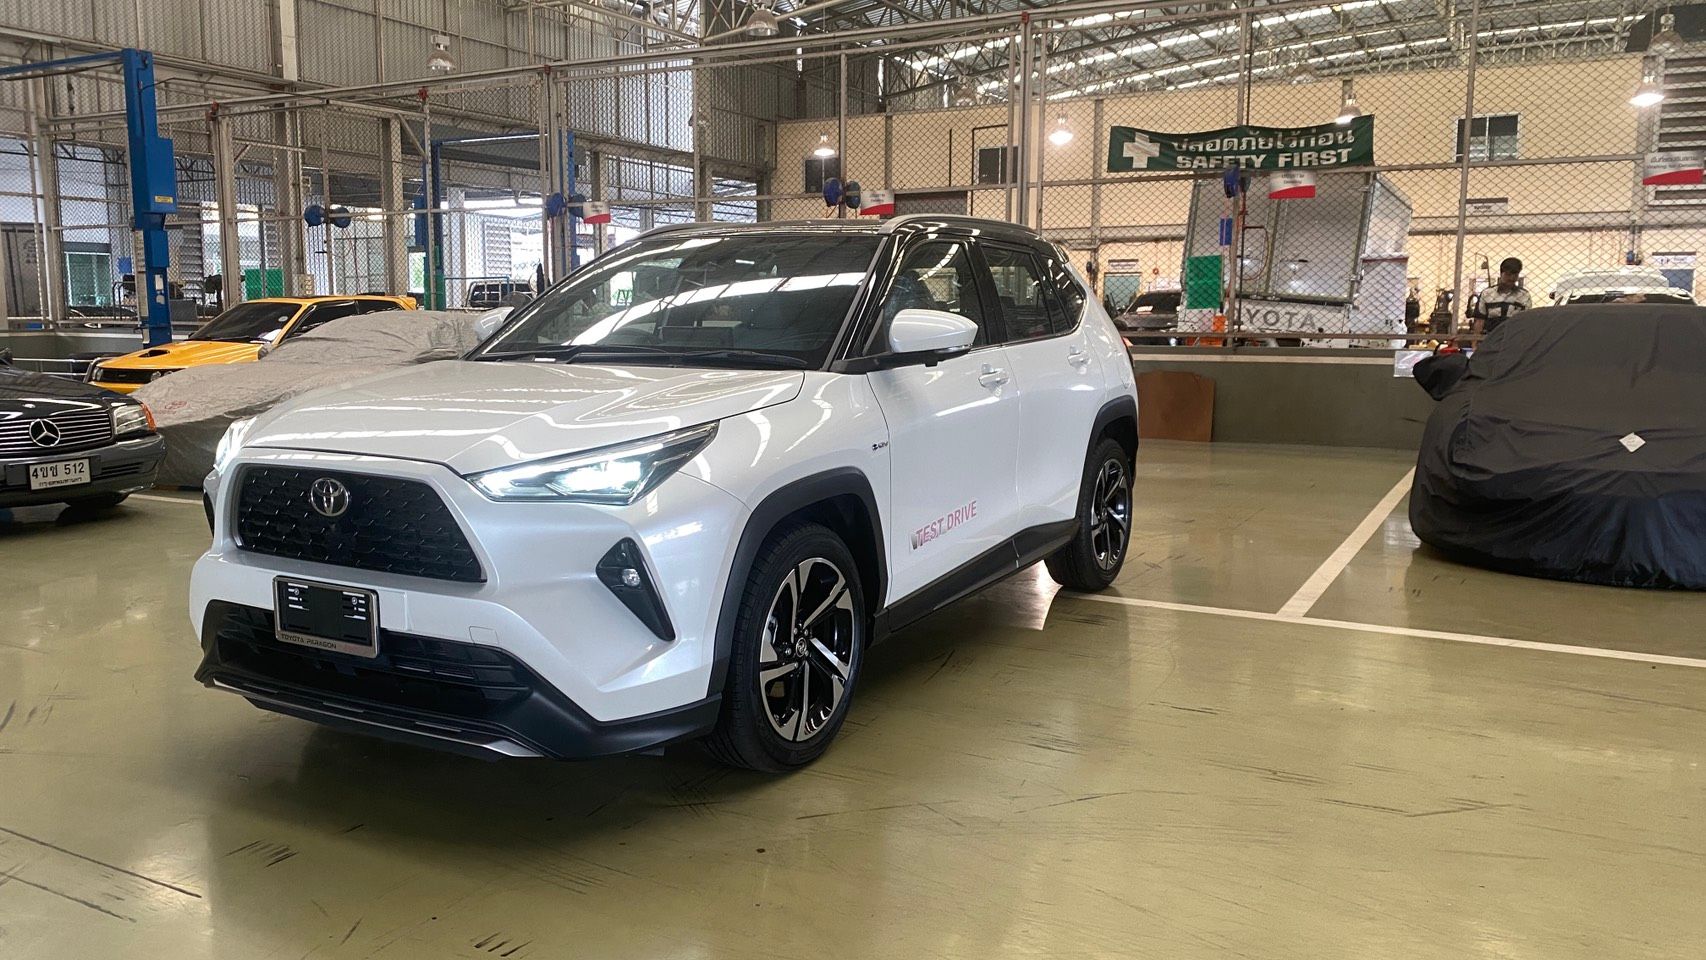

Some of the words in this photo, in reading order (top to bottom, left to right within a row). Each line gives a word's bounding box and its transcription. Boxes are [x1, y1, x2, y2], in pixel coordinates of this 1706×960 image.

[1171, 128, 1355, 152] ปลอดภัยไว้ก่อน
[1176, 154, 1267, 169] SAFETY
[1278, 147, 1353, 167] FIRST
[1245, 308, 1316, 329] YOTA
[64, 462, 85, 475] 512
[916, 517, 945, 547] TEST
[947, 500, 977, 531] DRIVE
[281, 633, 305, 643] TOYOTA
